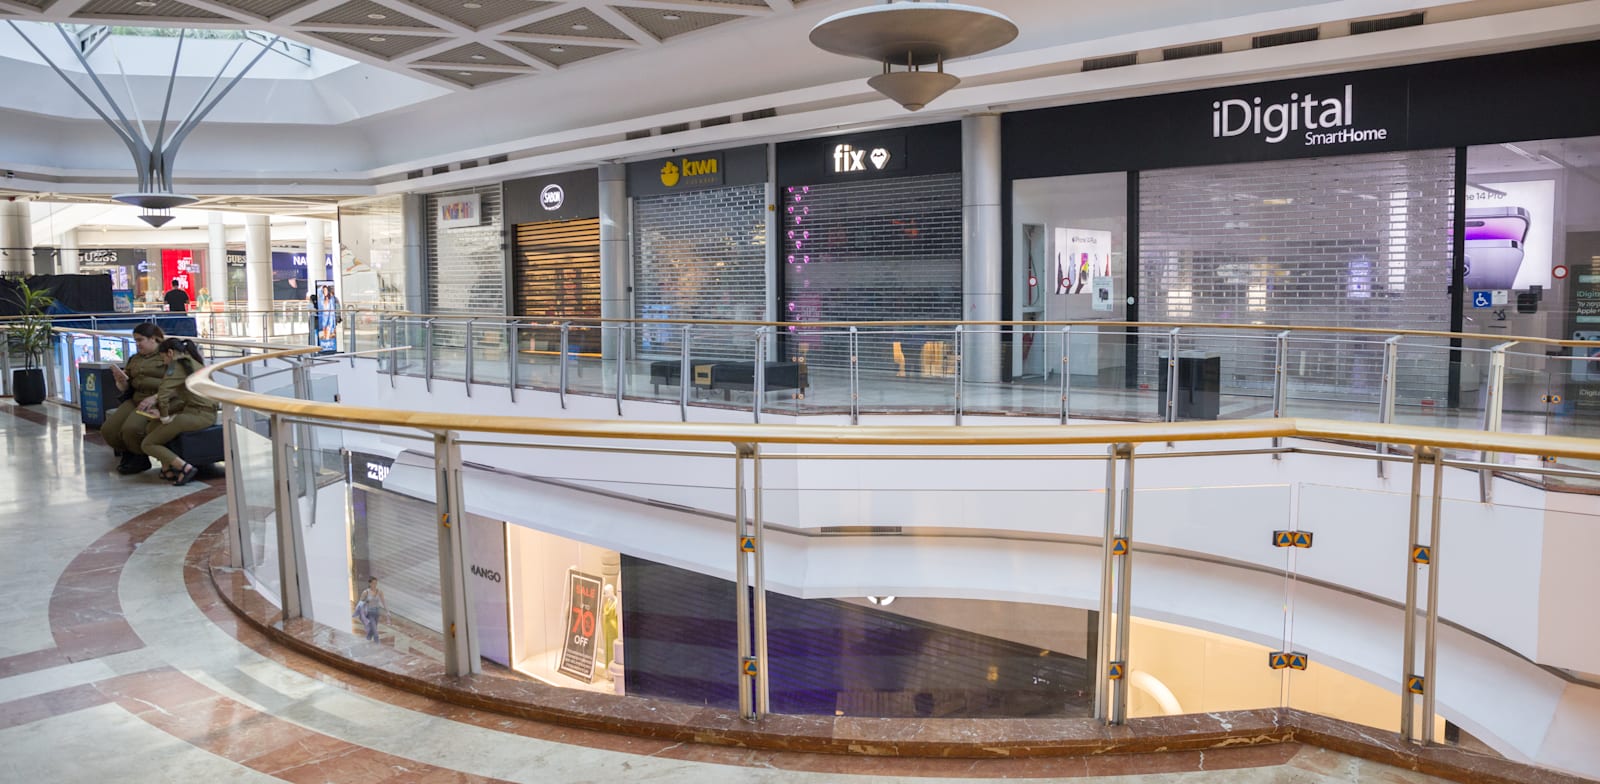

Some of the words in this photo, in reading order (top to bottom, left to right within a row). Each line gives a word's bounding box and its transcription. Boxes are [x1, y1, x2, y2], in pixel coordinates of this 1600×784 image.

[1213, 84, 1353, 144] iDigital
[1304, 128, 1388, 146] SmartHome
[833, 144, 867, 172] fix
[575, 584, 596, 599] SALE
[572, 607, 595, 637] 70
[574, 635, 589, 647] OFF
